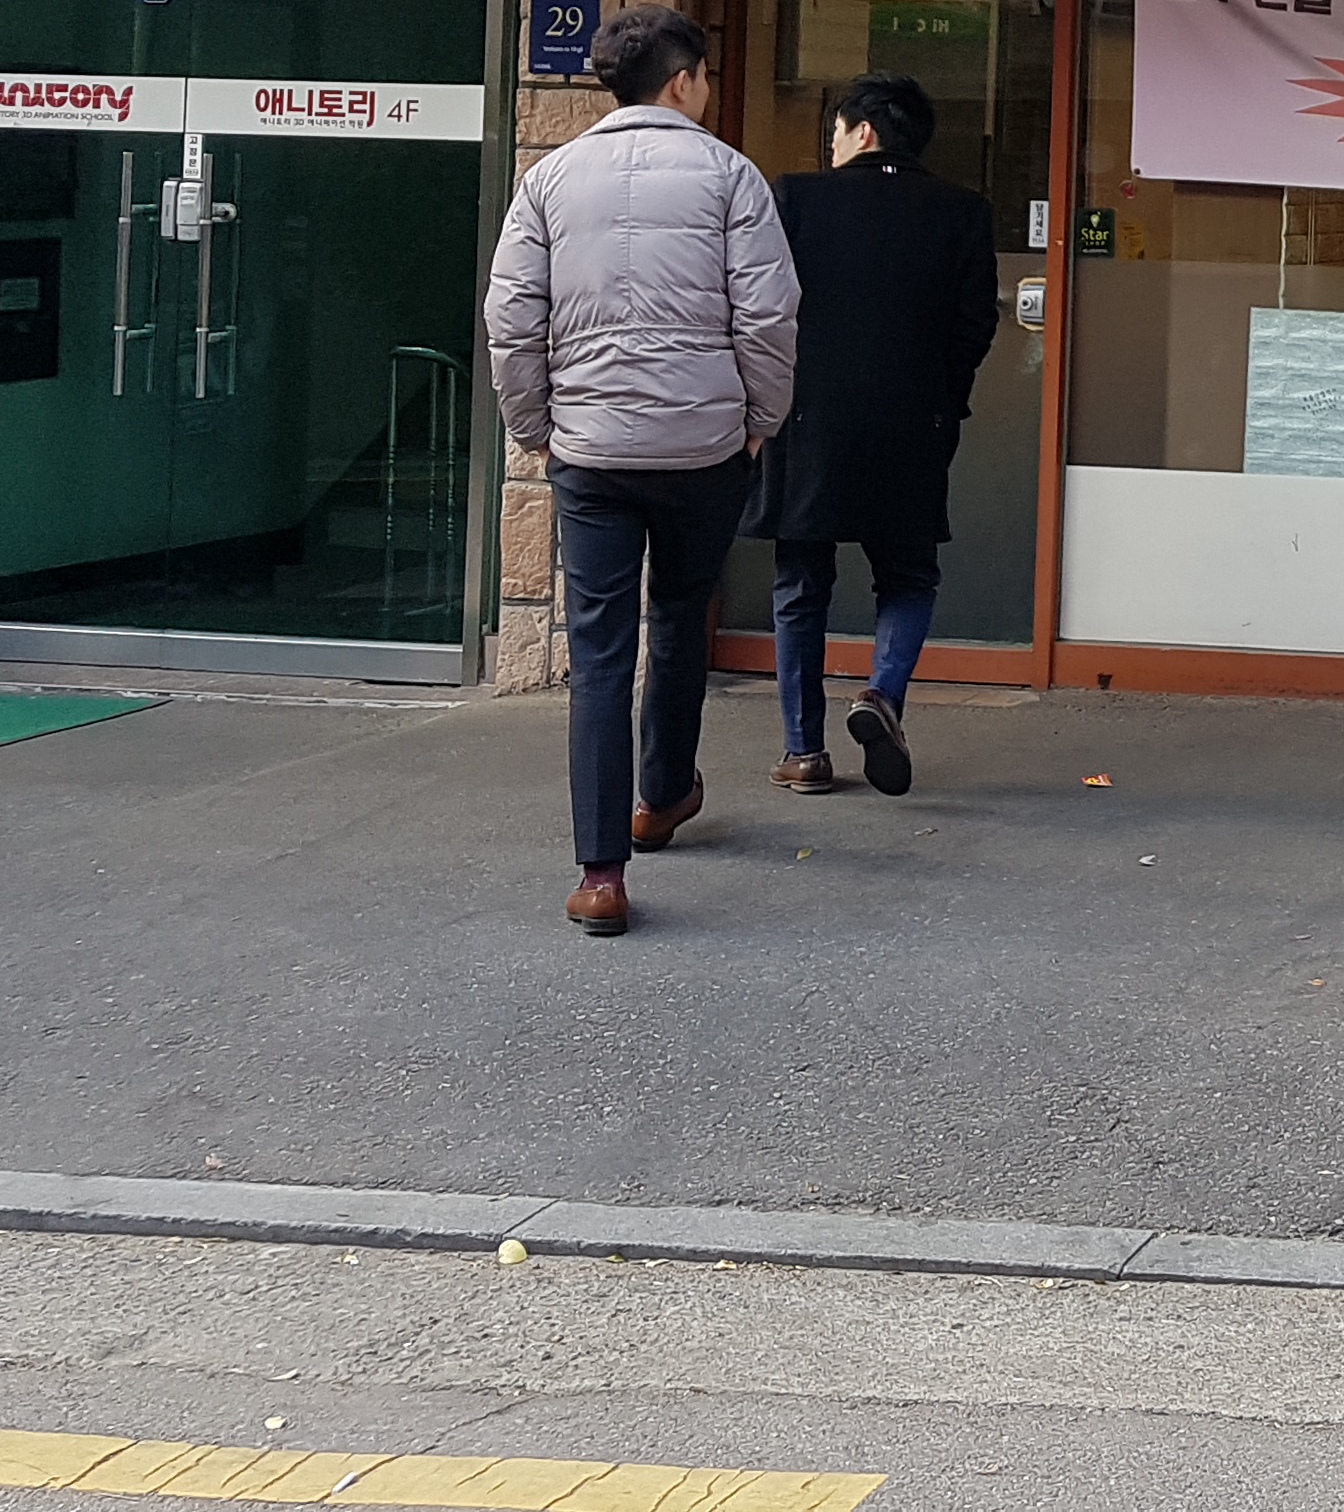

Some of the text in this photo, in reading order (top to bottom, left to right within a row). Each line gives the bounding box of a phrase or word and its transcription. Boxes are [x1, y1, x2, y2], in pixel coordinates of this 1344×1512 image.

[545, 6, 584, 37] 29
[255, 88, 420, 128] 애니토리 4F
[1081, 227, 1110, 241] Star
